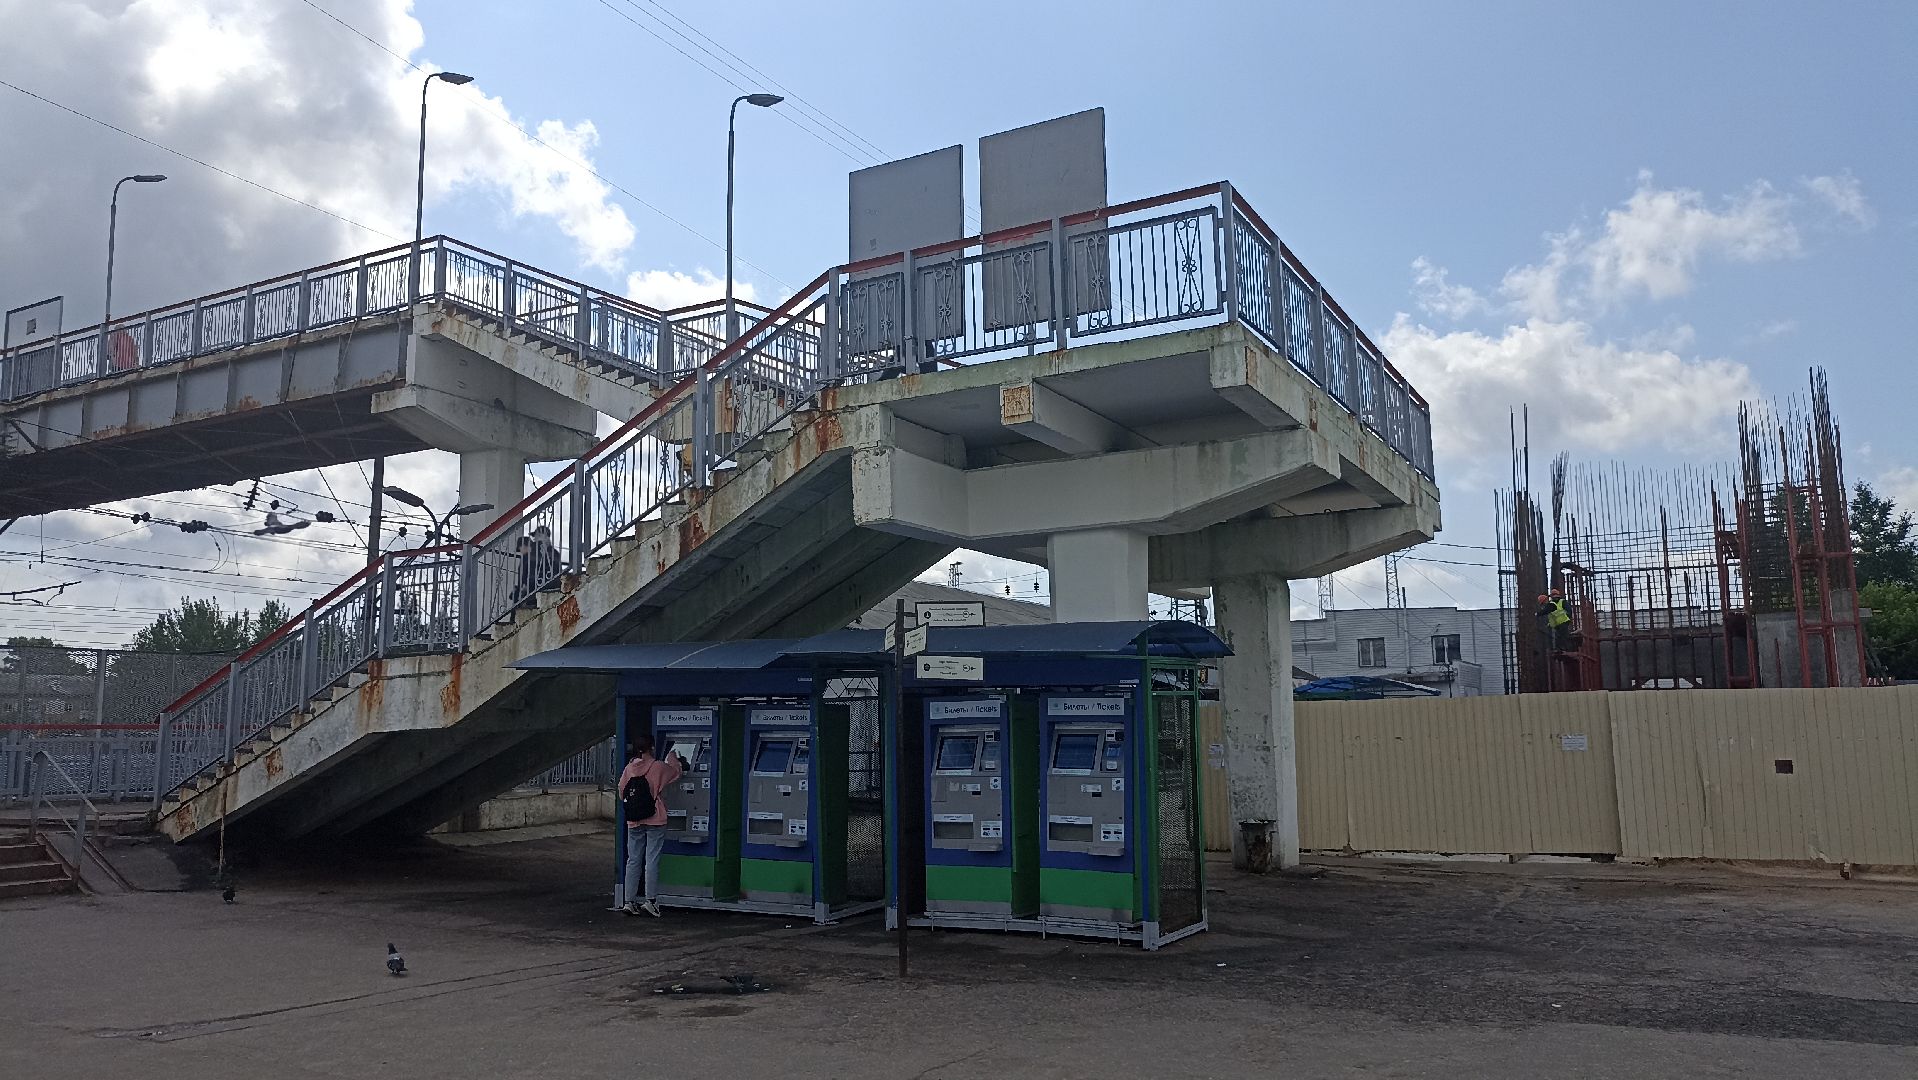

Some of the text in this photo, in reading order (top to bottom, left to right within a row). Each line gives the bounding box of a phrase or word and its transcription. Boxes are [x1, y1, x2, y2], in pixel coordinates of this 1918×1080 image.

[944, 706, 969, 714] Билеты
[975, 705, 999, 713] Tickets
[1063, 703, 1090, 711] Билеты
[1096, 702, 1121, 711] Tickets
